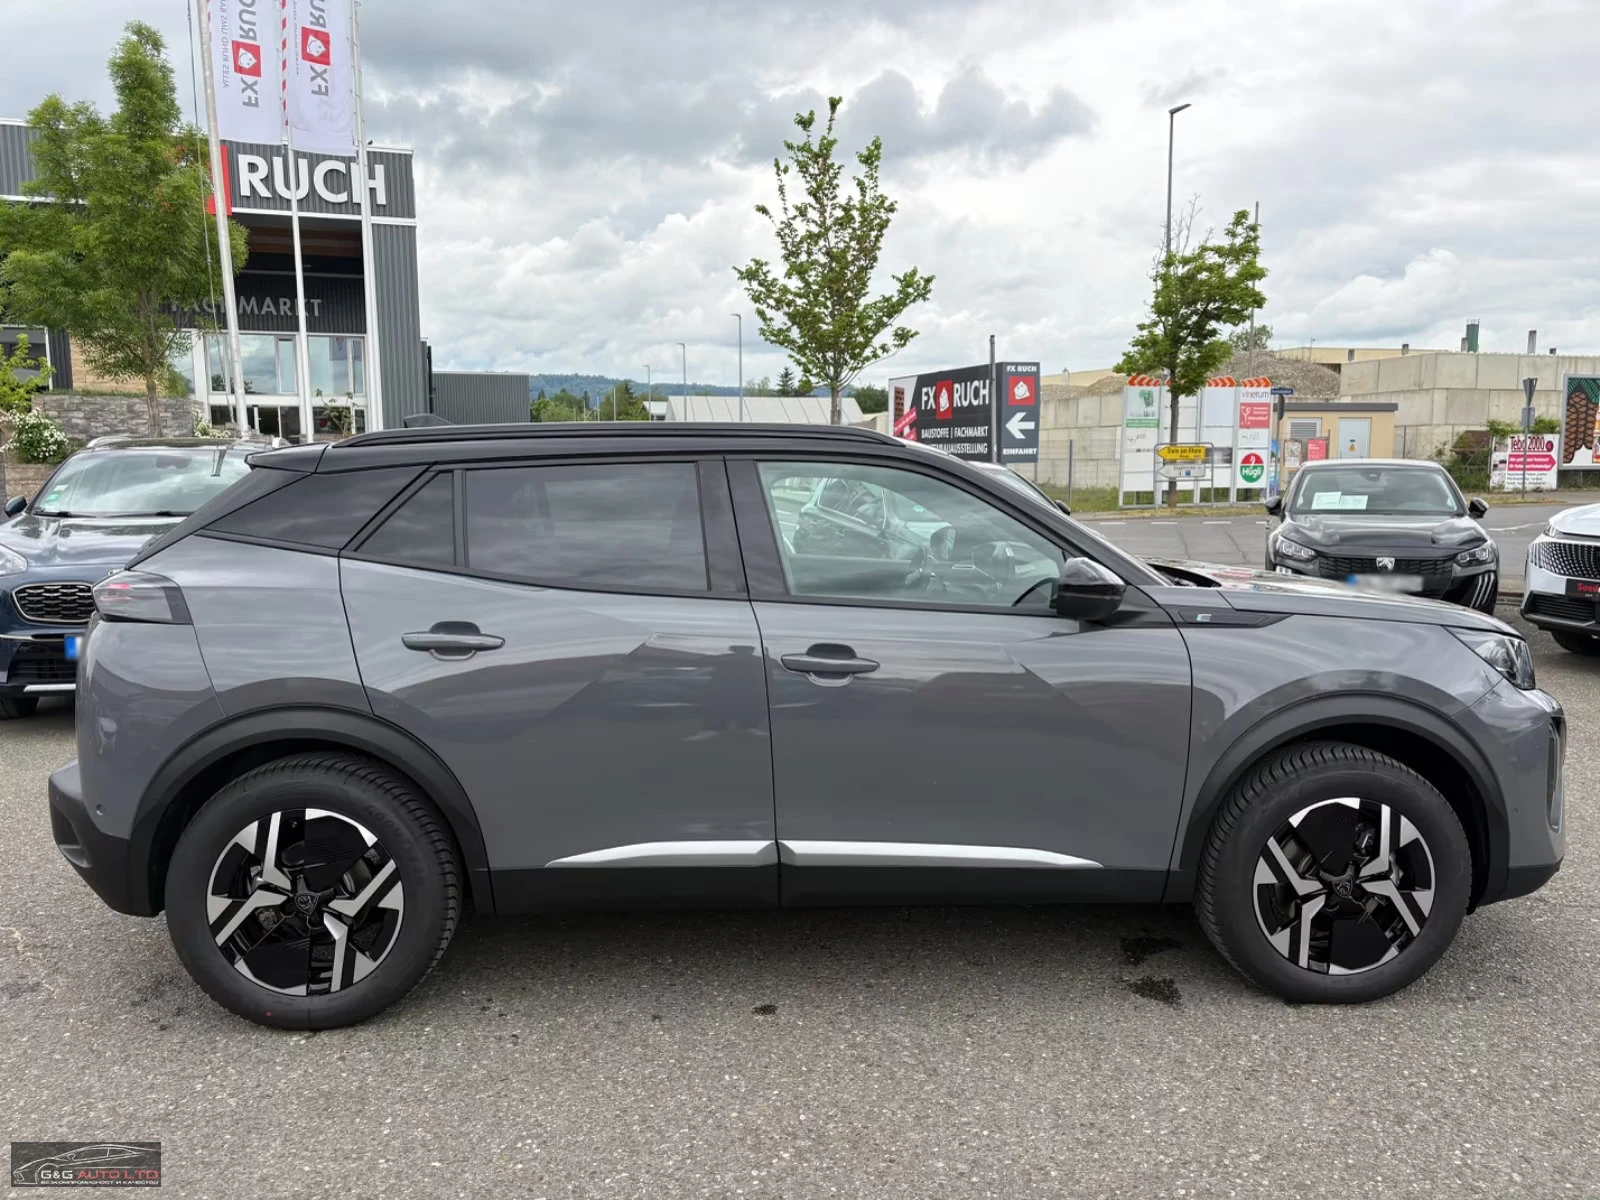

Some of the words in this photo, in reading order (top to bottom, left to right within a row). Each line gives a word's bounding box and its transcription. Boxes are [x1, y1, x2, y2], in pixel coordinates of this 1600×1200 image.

[238, 154, 387, 206] RUCH
[921, 386, 936, 411] FX
[953, 379, 990, 408] RUCH
[921, 428, 950, 439] BAUSTOFFE
[954, 426, 989, 438] FACHMARKT
[1528, 436, 1545, 450] 2000
